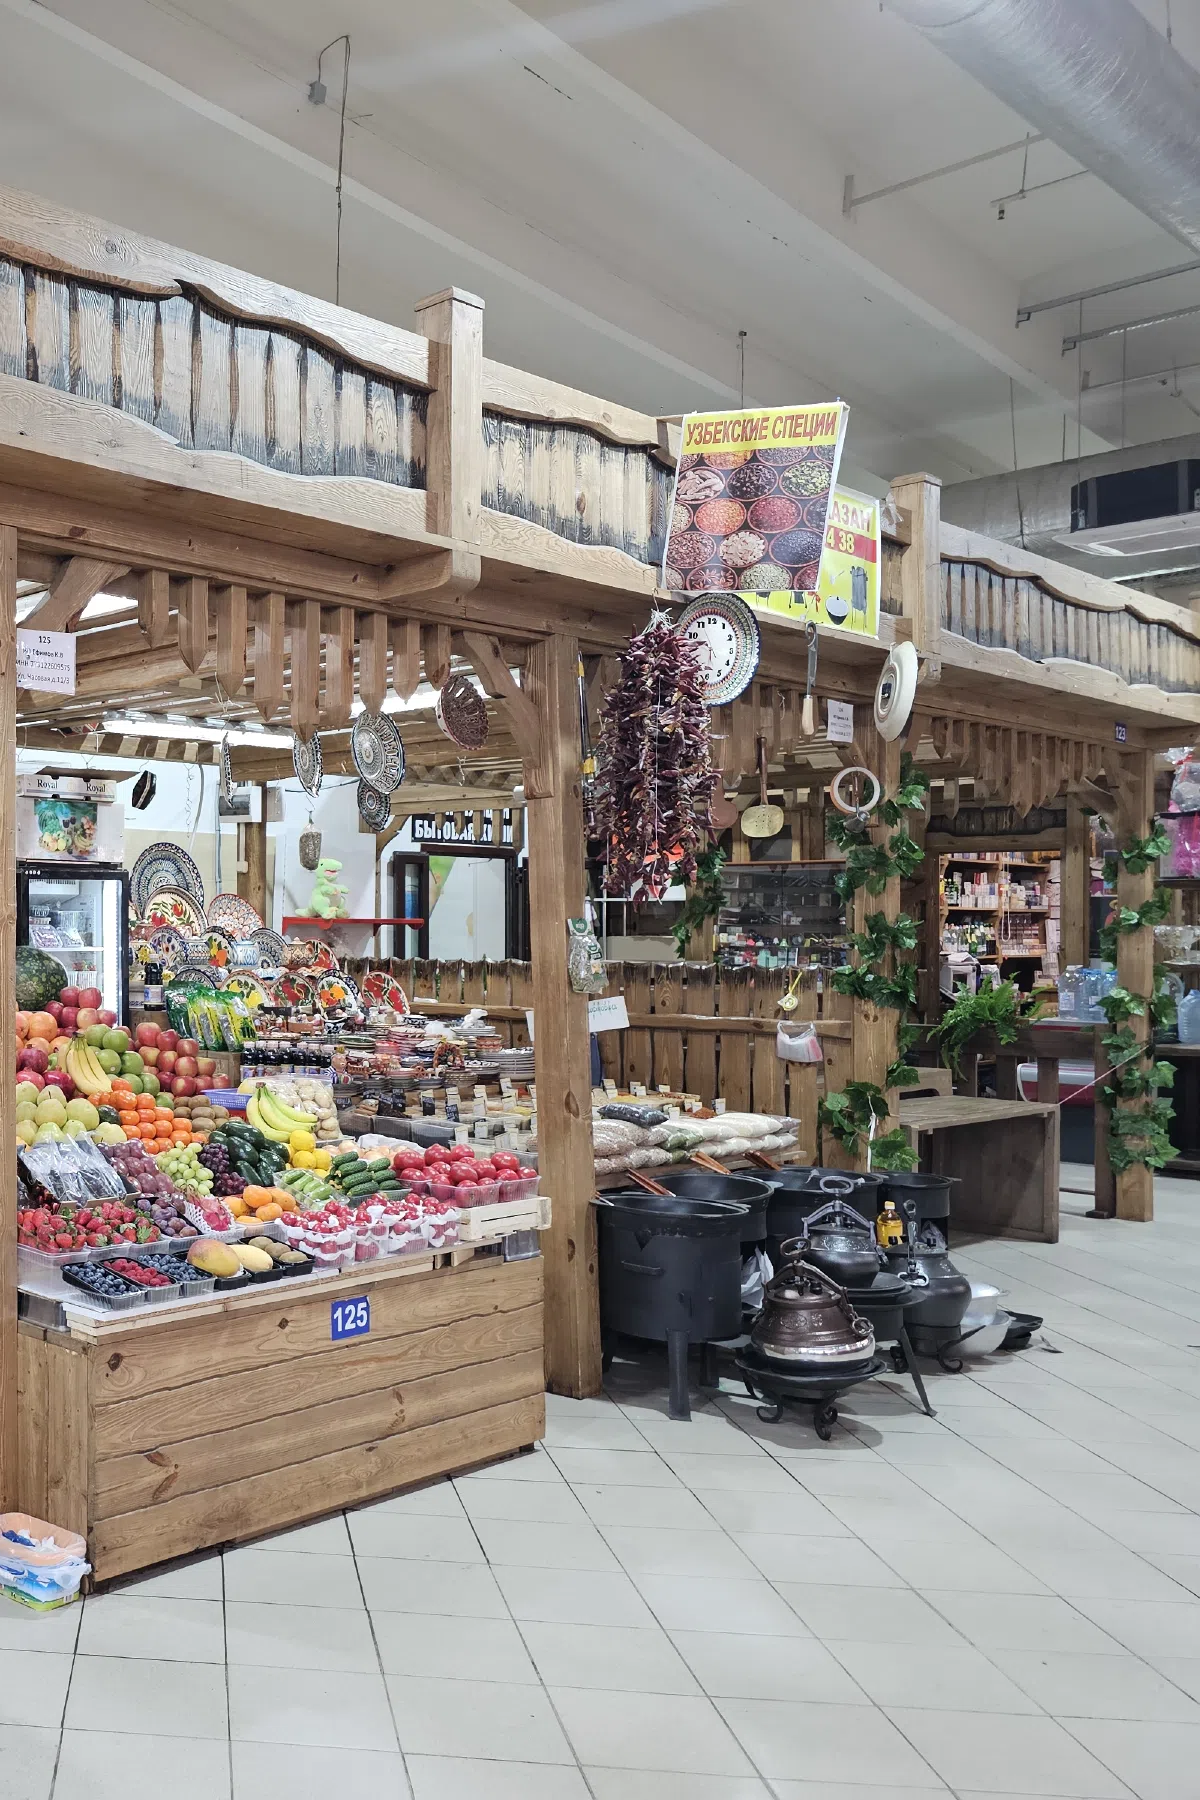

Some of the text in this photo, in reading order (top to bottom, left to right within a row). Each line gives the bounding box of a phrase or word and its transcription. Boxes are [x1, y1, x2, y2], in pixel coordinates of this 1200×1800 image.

[685, 411, 838, 446] УЗБЕКСКИЕ СПЕЦИИ
[828, 500, 873, 533] АЗАН
[838, 530, 855, 554] 38
[38, 635, 51, 645] 125
[1115, 725, 1126, 741] 123
[37, 778, 106, 794] Royal Royal
[333, 1302, 368, 1332] 125
